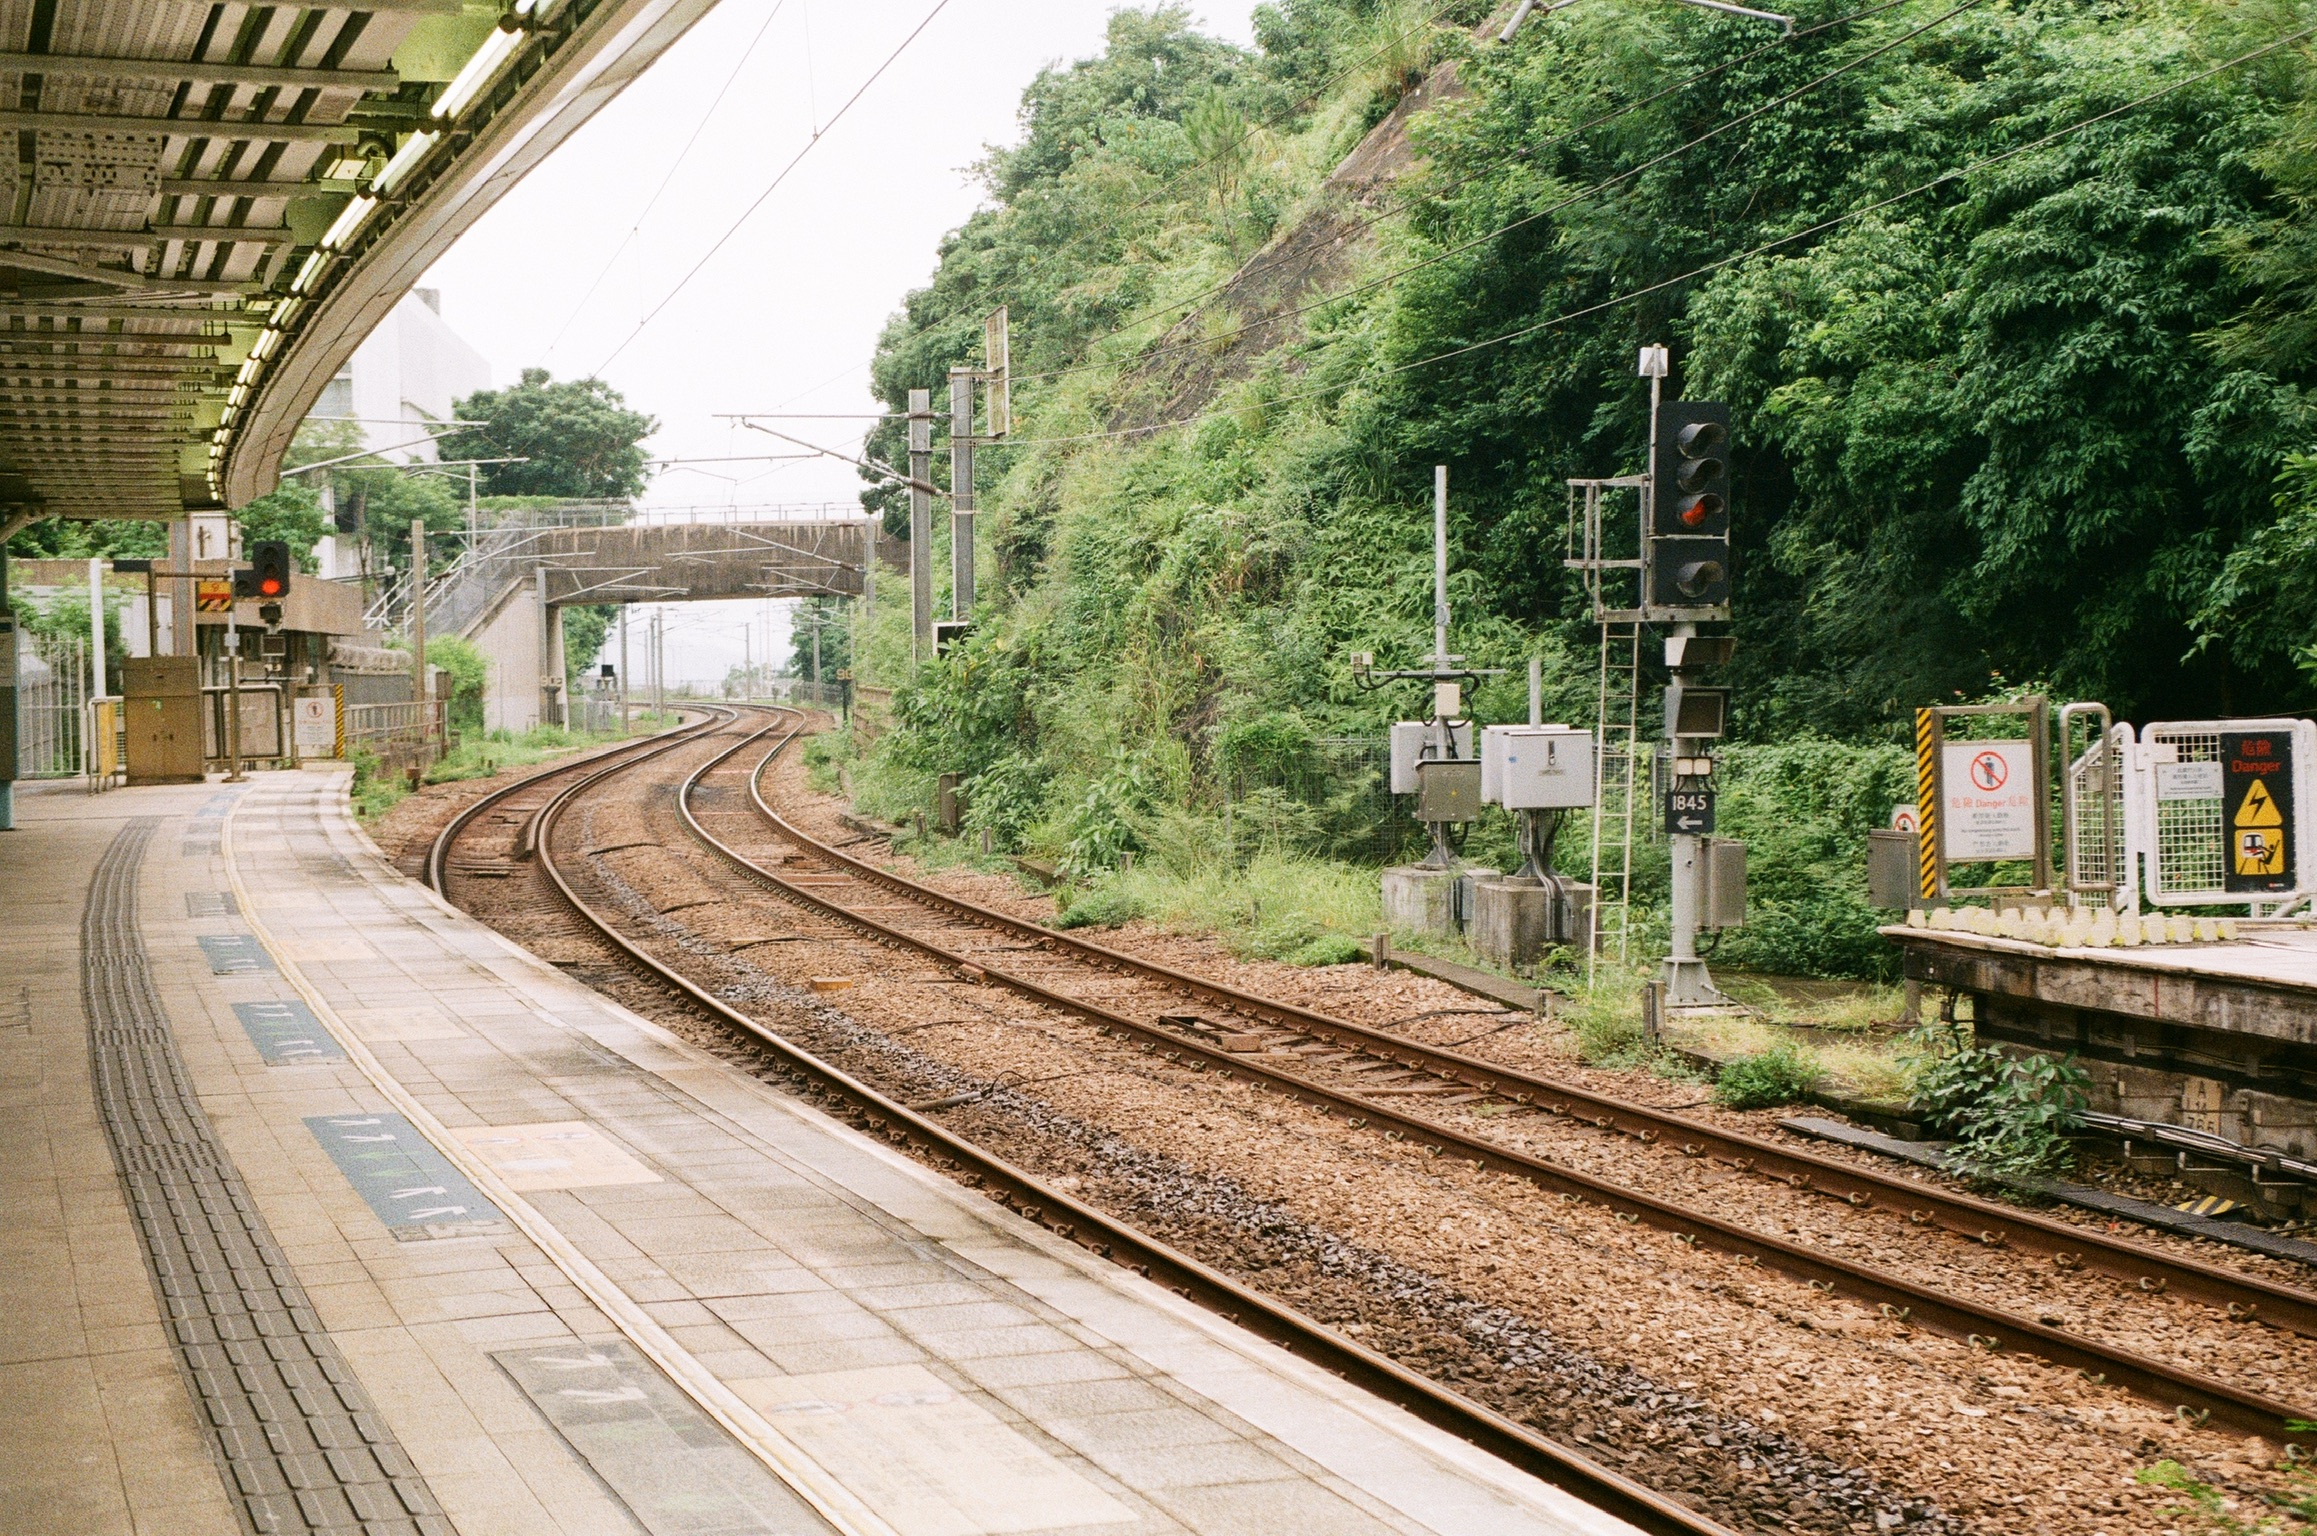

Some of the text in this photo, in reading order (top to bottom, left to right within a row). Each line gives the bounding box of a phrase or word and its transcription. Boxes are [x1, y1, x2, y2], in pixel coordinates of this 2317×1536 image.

[2242, 740, 2272, 756] 危險
[2231, 760, 2281, 775] Danger
[1672, 795, 1707, 811] 1845
[1976, 797, 2007, 809] Danger
[2198, 1080, 2207, 1099] A
